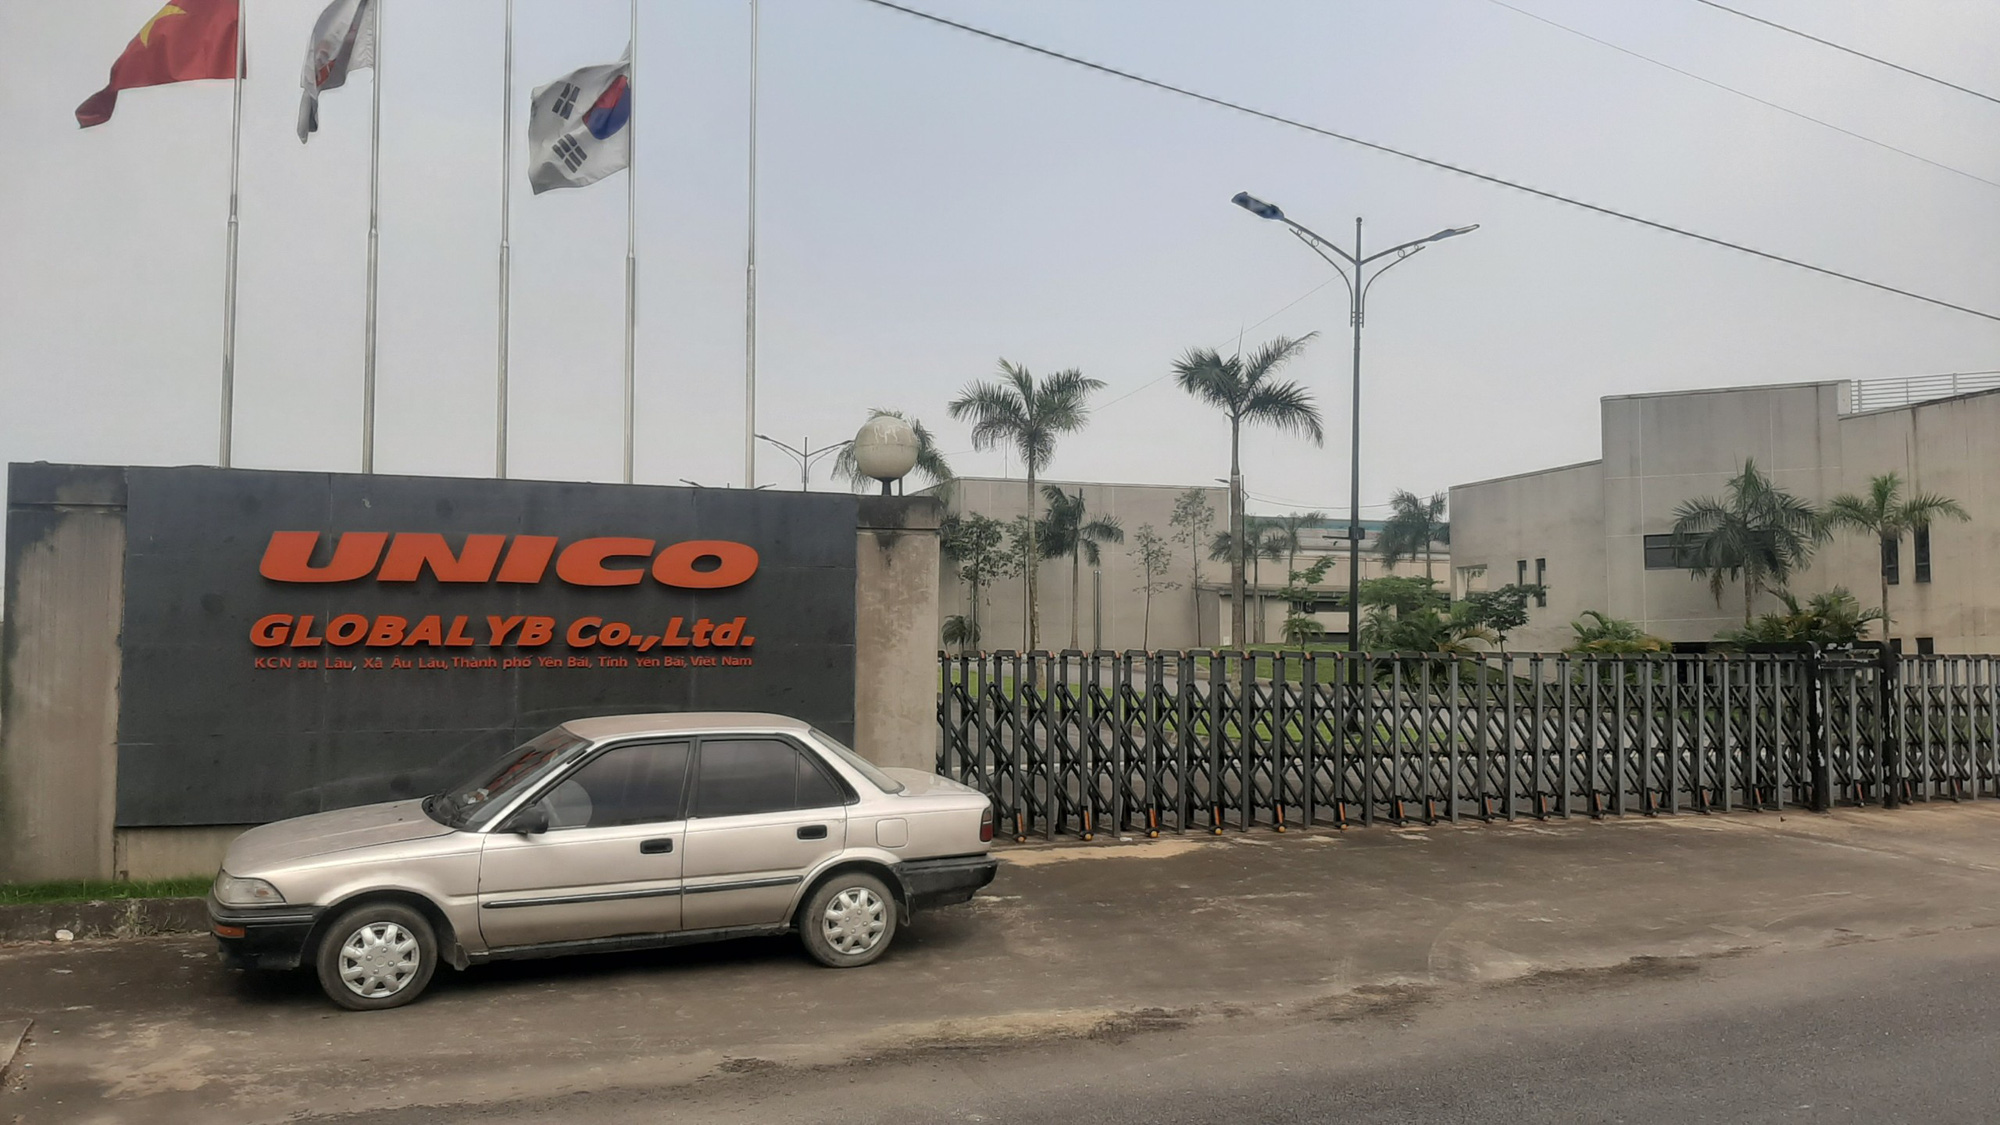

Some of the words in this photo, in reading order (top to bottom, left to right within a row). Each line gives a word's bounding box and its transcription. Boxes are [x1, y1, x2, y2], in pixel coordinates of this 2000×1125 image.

[260, 531, 759, 589] UNICO
[250, 613, 476, 648] GLOBAL
[486, 615, 556, 647] YB
[254, 656, 293, 670] KCN
[363, 656, 385, 670] Xã
[453, 655, 499, 669] Thành
[722, 655, 755, 667] Nam
